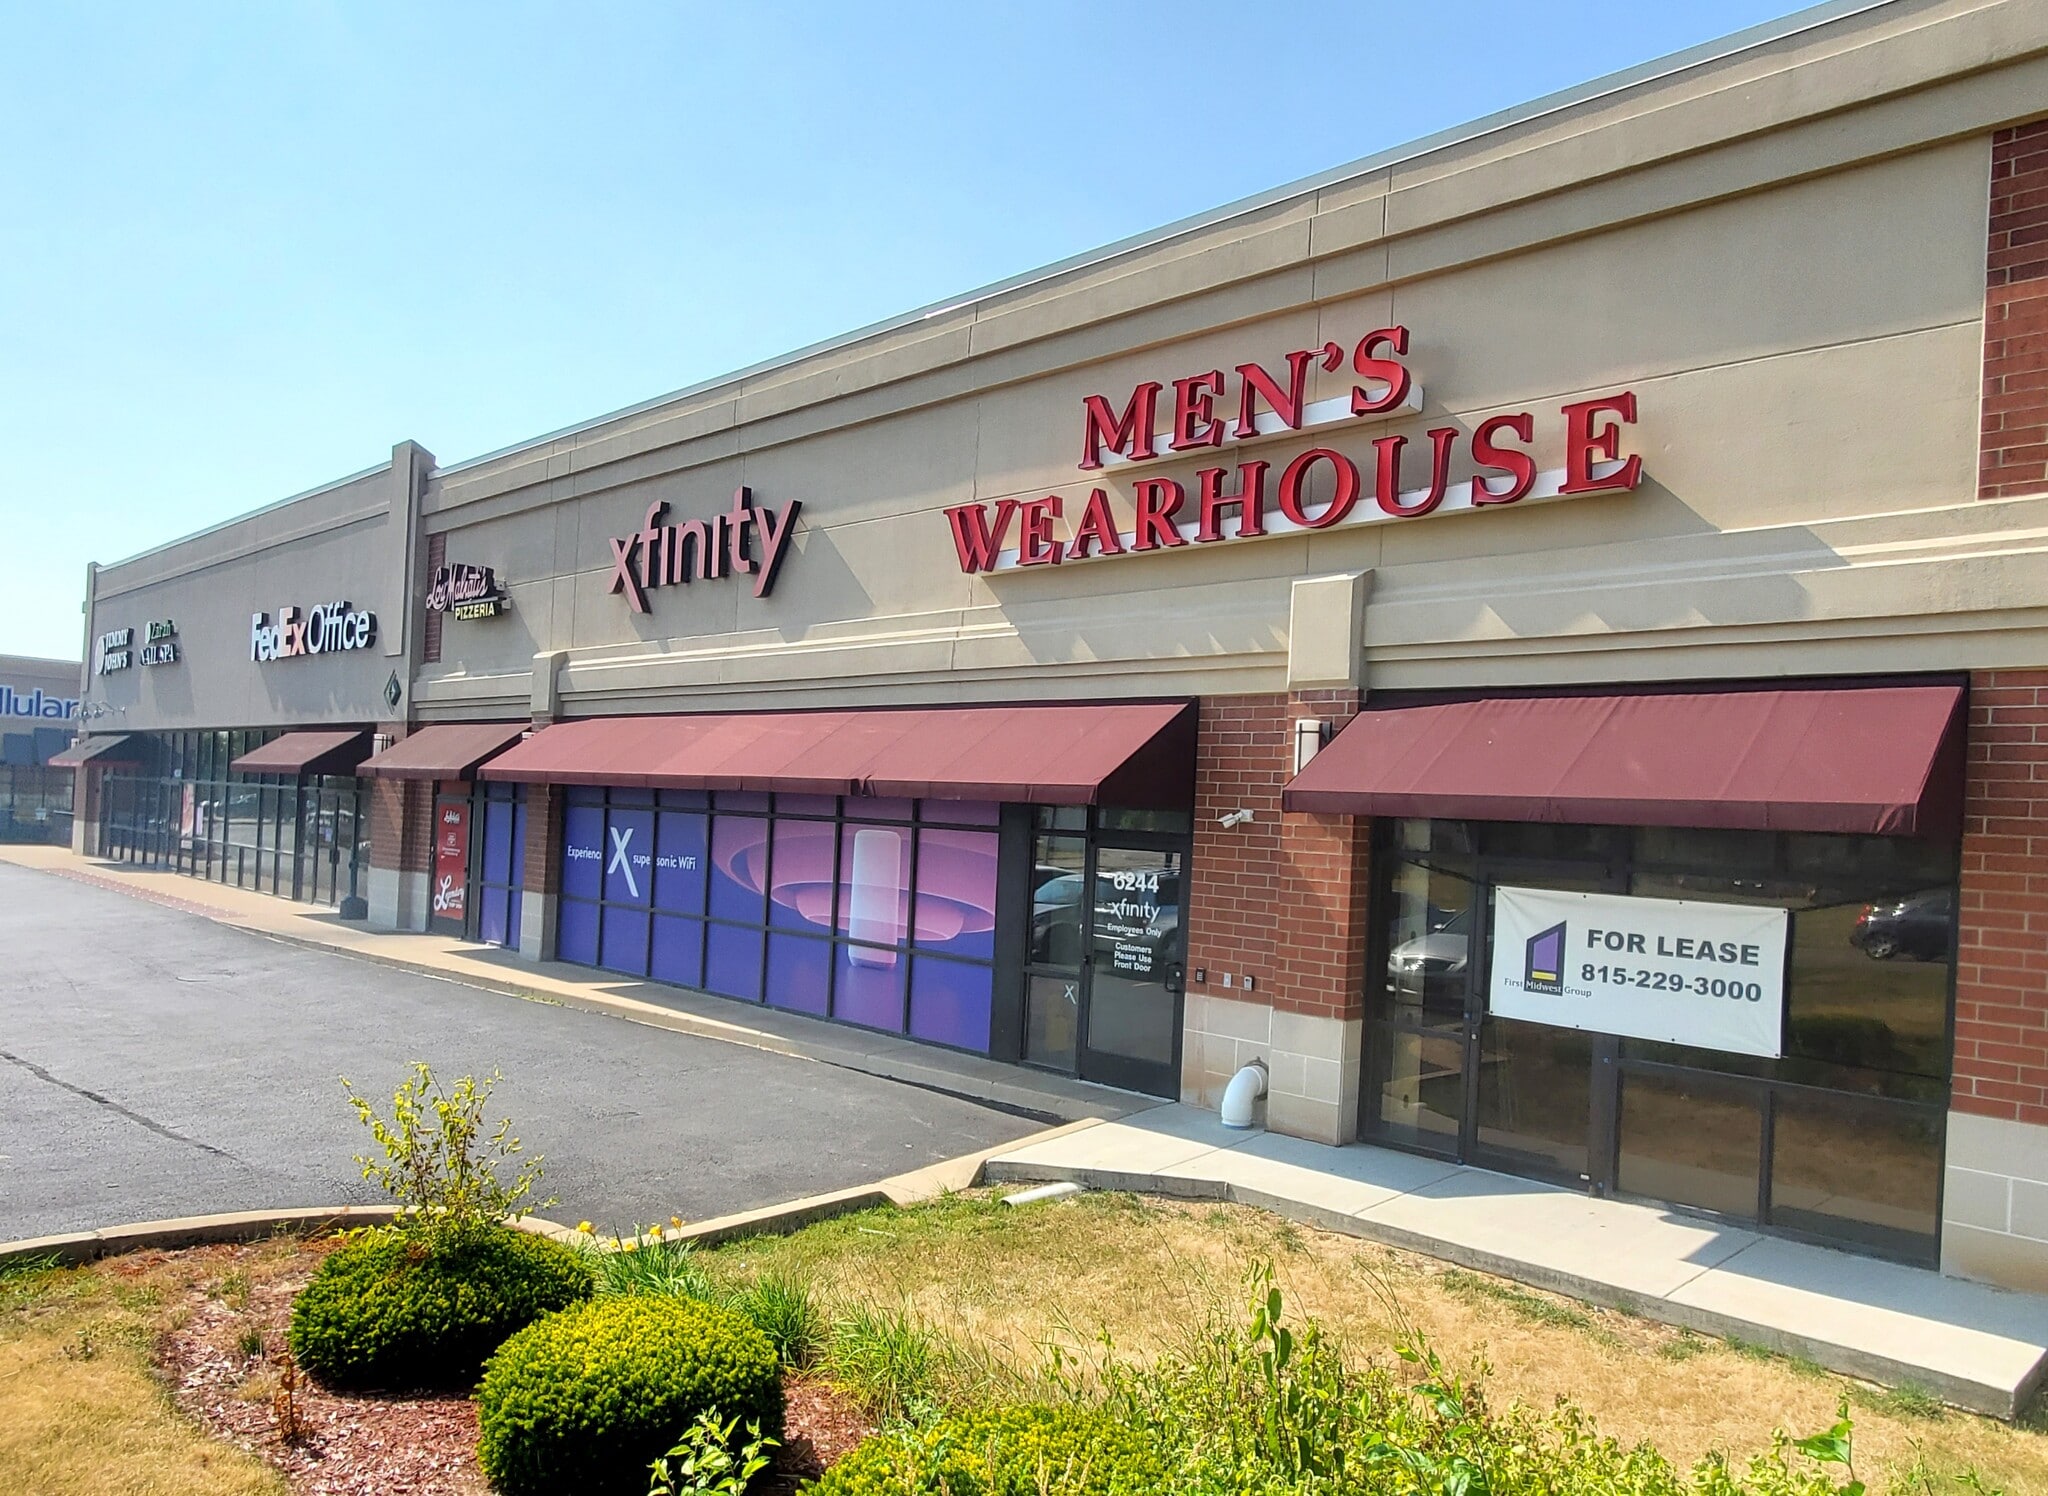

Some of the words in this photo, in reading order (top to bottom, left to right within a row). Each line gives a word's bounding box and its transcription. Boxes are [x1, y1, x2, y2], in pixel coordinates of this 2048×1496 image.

[1077, 325, 1413, 471] MEN'S
[943, 391, 1643, 574] WEARHOUSE
[609, 486, 802, 614] xfinity
[455, 602, 495, 620] PIZZERIA
[307, 601, 372, 655] Office
[105, 628, 130, 653] JIMMY
[567, 845, 602, 861] Experienc
[1113, 871, 1160, 893] 6244
[1110, 898, 1160, 923] xfinity
[1107, 923, 1144, 935] Employees
[1146, 927, 1162, 938] Only
[1114, 951, 1137, 961] Please
[1138, 954, 1152, 963] Use
[1115, 942, 1152, 954] Customers
[1586, 929, 1647, 955] FOR
[1657, 936, 1760, 967] LEASE
[1114, 960, 1132, 970] Front
[1134, 963, 1152, 972] Door
[1504, 977, 1524, 988] First
[1526, 980, 1562, 994] Midwest
[1564, 986, 1592, 998] Group
[1581, 963, 1762, 1003] 815-229-3000
